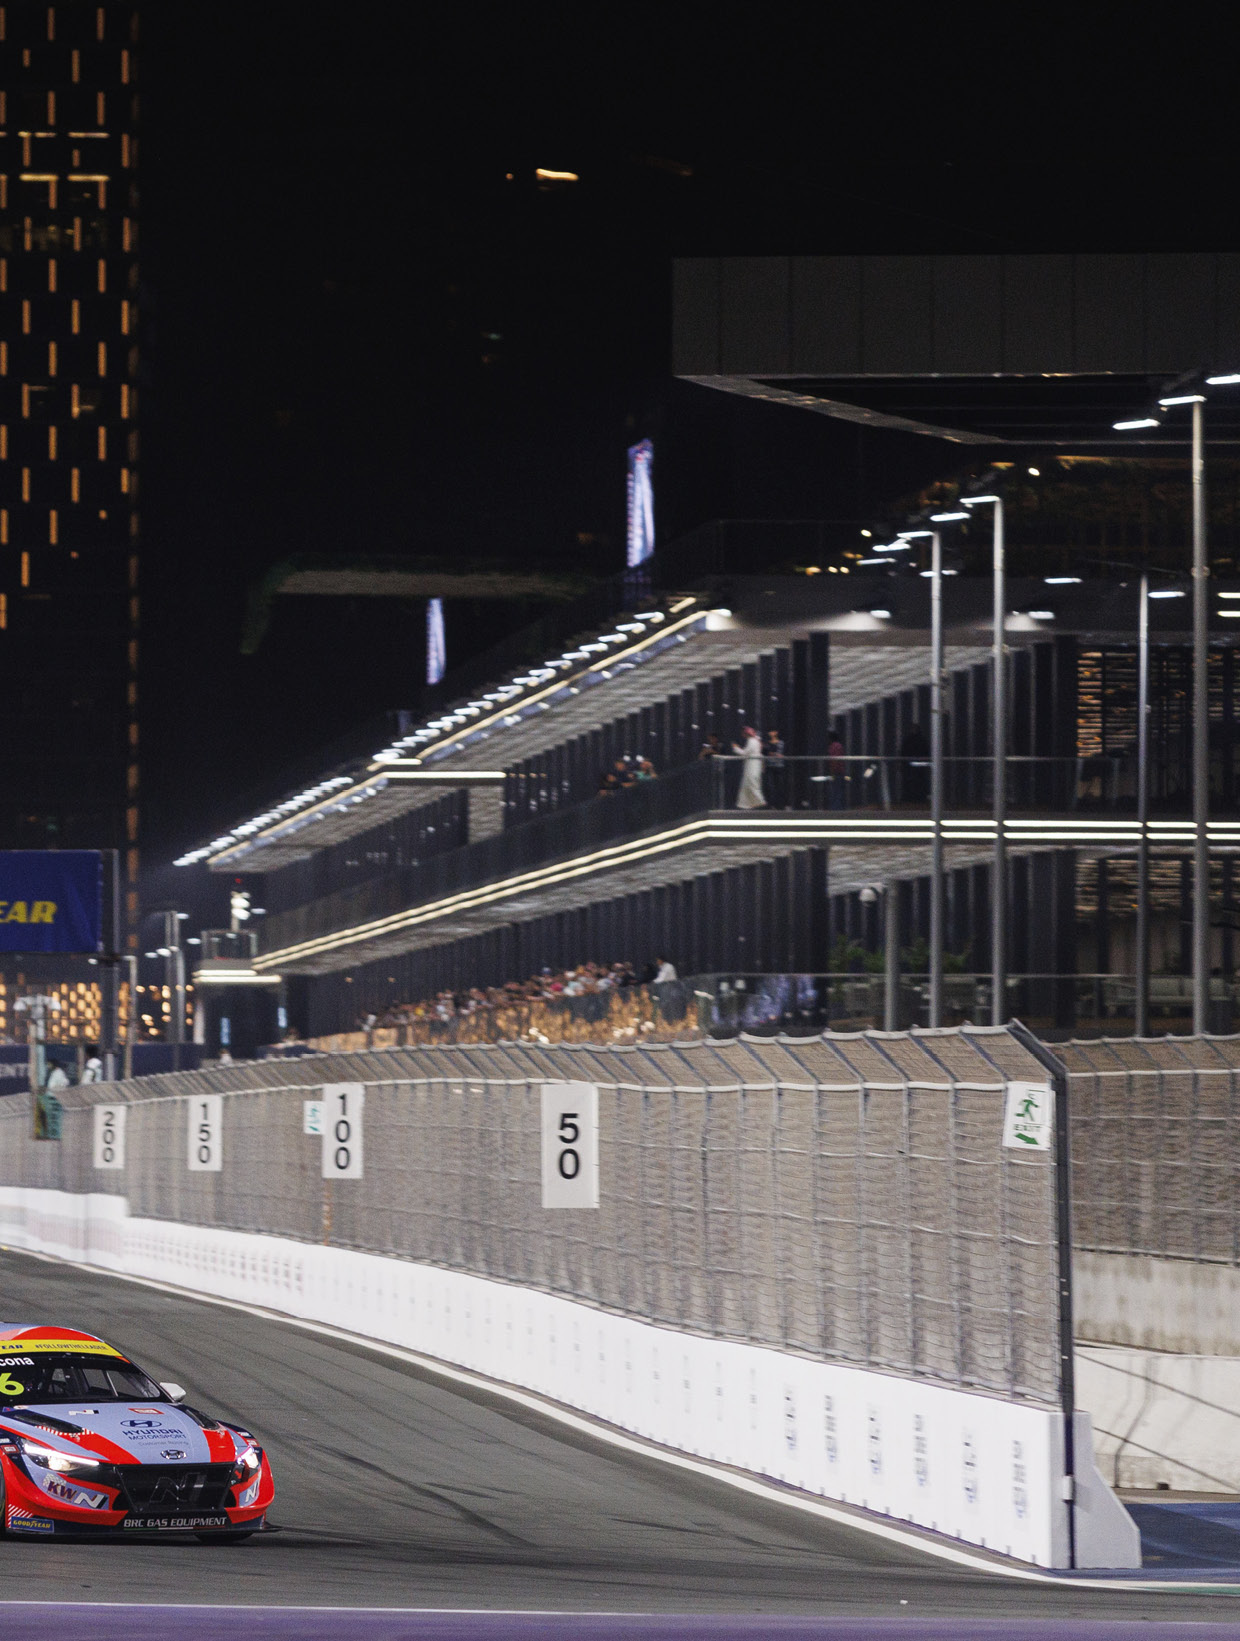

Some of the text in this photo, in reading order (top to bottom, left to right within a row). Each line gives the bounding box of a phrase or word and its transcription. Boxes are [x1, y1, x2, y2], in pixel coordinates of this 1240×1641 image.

[102, 1111, 116, 1163] 200
[198, 1102, 212, 1164] 150
[334, 1093, 351, 1170] 100
[558, 1113, 580, 1180] 50
[47, 1480, 77, 1501] KW
[13, 1519, 51, 1529] GOODYEAR
[124, 1516, 227, 1528] BRC GAS EQUIPMENT
